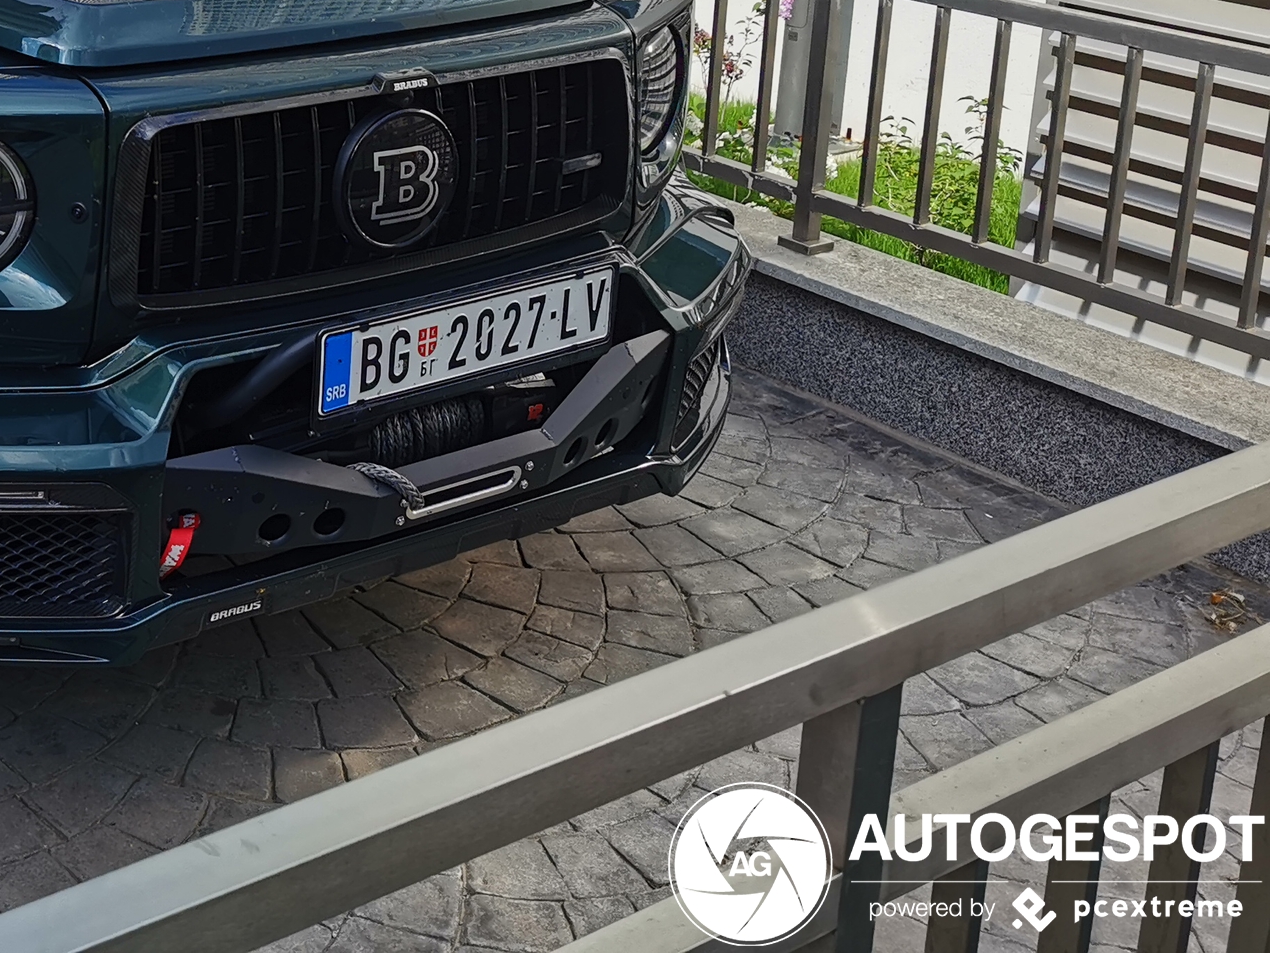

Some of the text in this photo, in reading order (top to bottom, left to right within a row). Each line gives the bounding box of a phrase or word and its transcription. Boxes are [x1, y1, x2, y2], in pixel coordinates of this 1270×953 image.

[393, 78, 428, 91] BRABUS
[371, 145, 439, 226] B
[359, 329, 412, 393] BG
[325, 383, 346, 402] SRB
[210, 600, 262, 622] BRABUS
